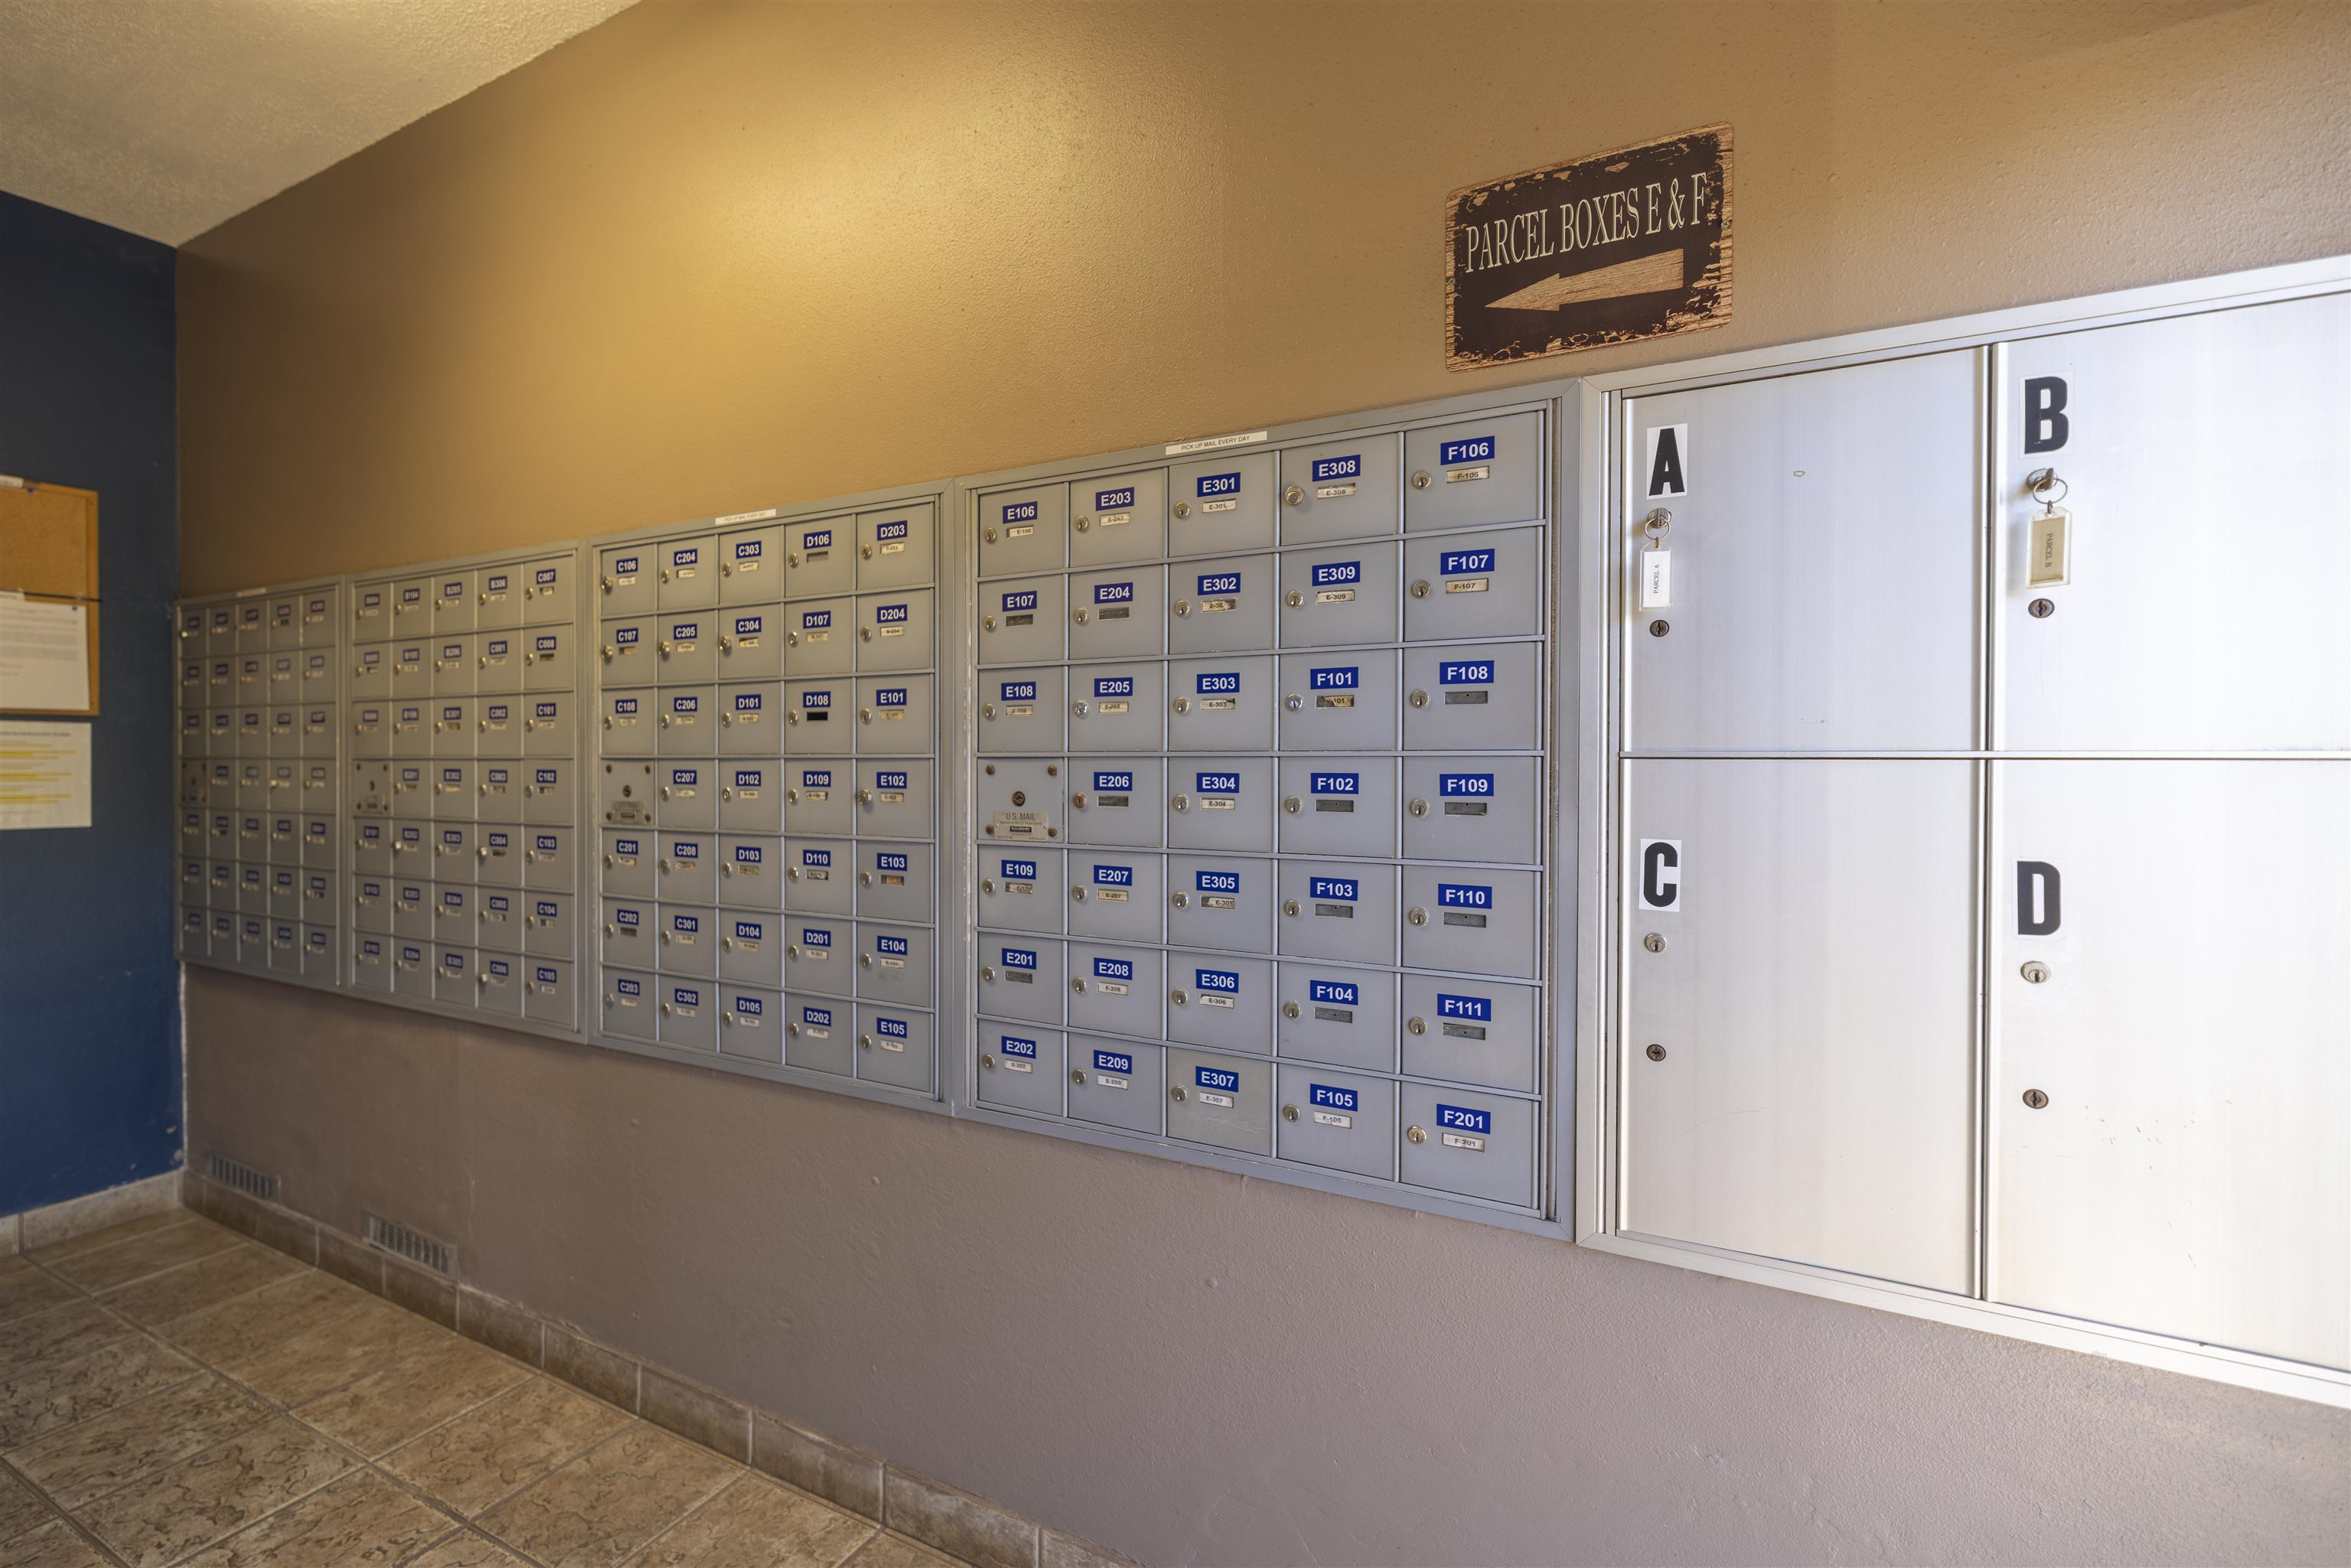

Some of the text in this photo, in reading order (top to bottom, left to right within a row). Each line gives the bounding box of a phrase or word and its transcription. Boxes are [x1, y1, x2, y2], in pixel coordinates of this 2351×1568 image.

[1465, 172, 1707, 273] PARCEL BOXES E & F
[2024, 376, 2069, 455] B
[1448, 442, 1489, 461] F106
[1648, 428, 1685, 496] A
[1319, 460, 1356, 478] E308
[1202, 477, 1235, 493] E301
[1101, 491, 1131, 507] E203
[1006, 505, 1035, 520] E106
[880, 523, 905, 538] D203
[807, 533, 829, 546] D106
[738, 543, 759, 555] C303
[2045, 533, 2053, 560] PARCEL
[676, 552, 696, 563] C204
[1448, 554, 1489, 571] F107
[618, 560, 637, 571] C106
[1318, 566, 1355, 582] E309
[1203, 577, 1237, 592] E302
[1100, 586, 1130, 600] E204
[1006, 595, 1035, 608] E107
[806, 614, 829, 627] D107
[880, 608, 905, 621] D204
[676, 627, 696, 637] C205
[738, 620, 758, 632] C304
[618, 631, 637, 641] C107
[1317, 672, 1352, 686] F101
[1447, 666, 1489, 680] F108
[1099, 681, 1130, 693] E205
[1202, 676, 1236, 690] E303
[880, 692, 904, 703] E101
[1006, 685, 1033, 698] E108
[618, 701, 635, 712] C108
[676, 699, 696, 709] C206
[738, 697, 758, 709] D101
[806, 694, 828, 706] D108
[538, 706, 554, 715] C101
[675, 772, 695, 783] C207
[738, 774, 759, 785] D102
[806, 774, 829, 785] D109
[880, 774, 905, 786] E102
[1099, 775, 1130, 787] E206
[1202, 777, 1236, 790] E304
[1317, 777, 1354, 791] F102
[1447, 778, 1489, 793] F109
[618, 842, 637, 852] C201
[677, 845, 695, 856] C208
[739, 849, 760, 861] D103
[806, 852, 828, 865] D110
[881, 856, 905, 869] E103
[1006, 863, 1033, 876] E109
[1098, 869, 1129, 882] E207
[1643, 842, 1678, 908] C
[1202, 875, 1235, 889] E305
[1317, 881, 1355, 898] F103
[1446, 888, 1485, 905] F110
[2017, 861, 2061, 935] D
[619, 912, 637, 923] C202
[677, 918, 696, 930] C301
[739, 925, 760, 937] D104
[806, 932, 828, 944] D201
[881, 939, 905, 952] E104
[1006, 951, 1033, 966] E201
[1099, 962, 1129, 976] E208
[620, 982, 638, 993] C203
[1202, 973, 1235, 989] E306
[677, 991, 697, 1004] C302
[1316, 985, 1354, 1002] F104
[739, 999, 761, 1013] D105
[1444, 999, 1482, 1016] F111
[807, 1010, 830, 1024] D202
[881, 1021, 905, 1035] E105
[1006, 1039, 1033, 1055] E202
[1099, 1054, 1130, 1071] E209
[1202, 1071, 1235, 1088] E307
[1317, 1088, 1355, 1107] F105
[1444, 1110, 1483, 1130] F201
